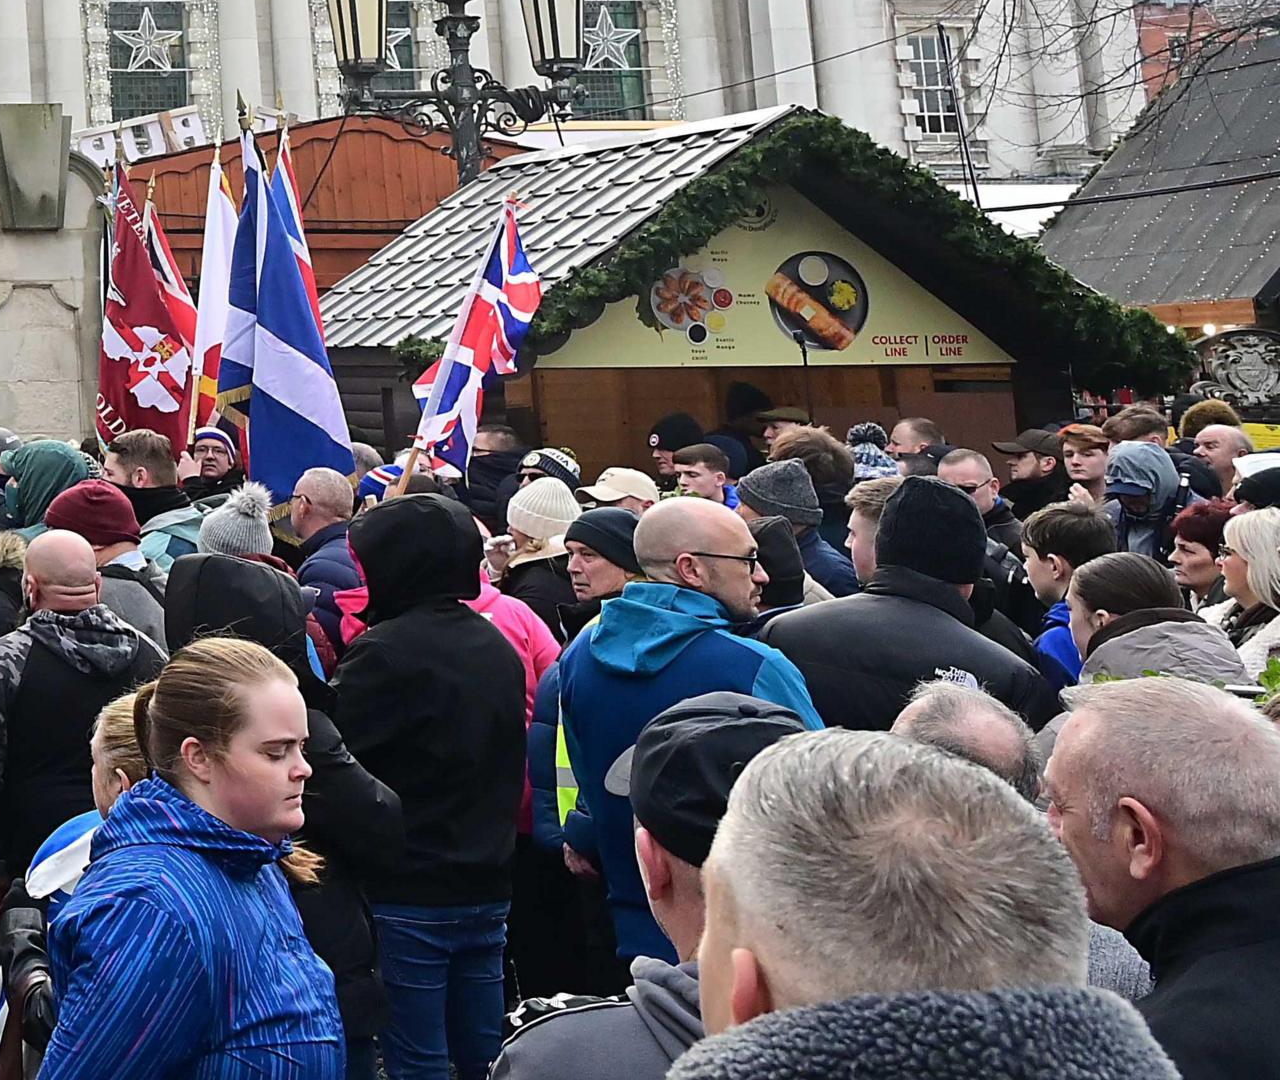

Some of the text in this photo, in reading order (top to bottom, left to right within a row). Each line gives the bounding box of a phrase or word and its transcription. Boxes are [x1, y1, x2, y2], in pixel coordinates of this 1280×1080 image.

[871, 335, 919, 345] COLLECT
[931, 335, 969, 345] ORDER
[884, 347, 908, 357] LINE
[939, 346, 963, 357] LINE
